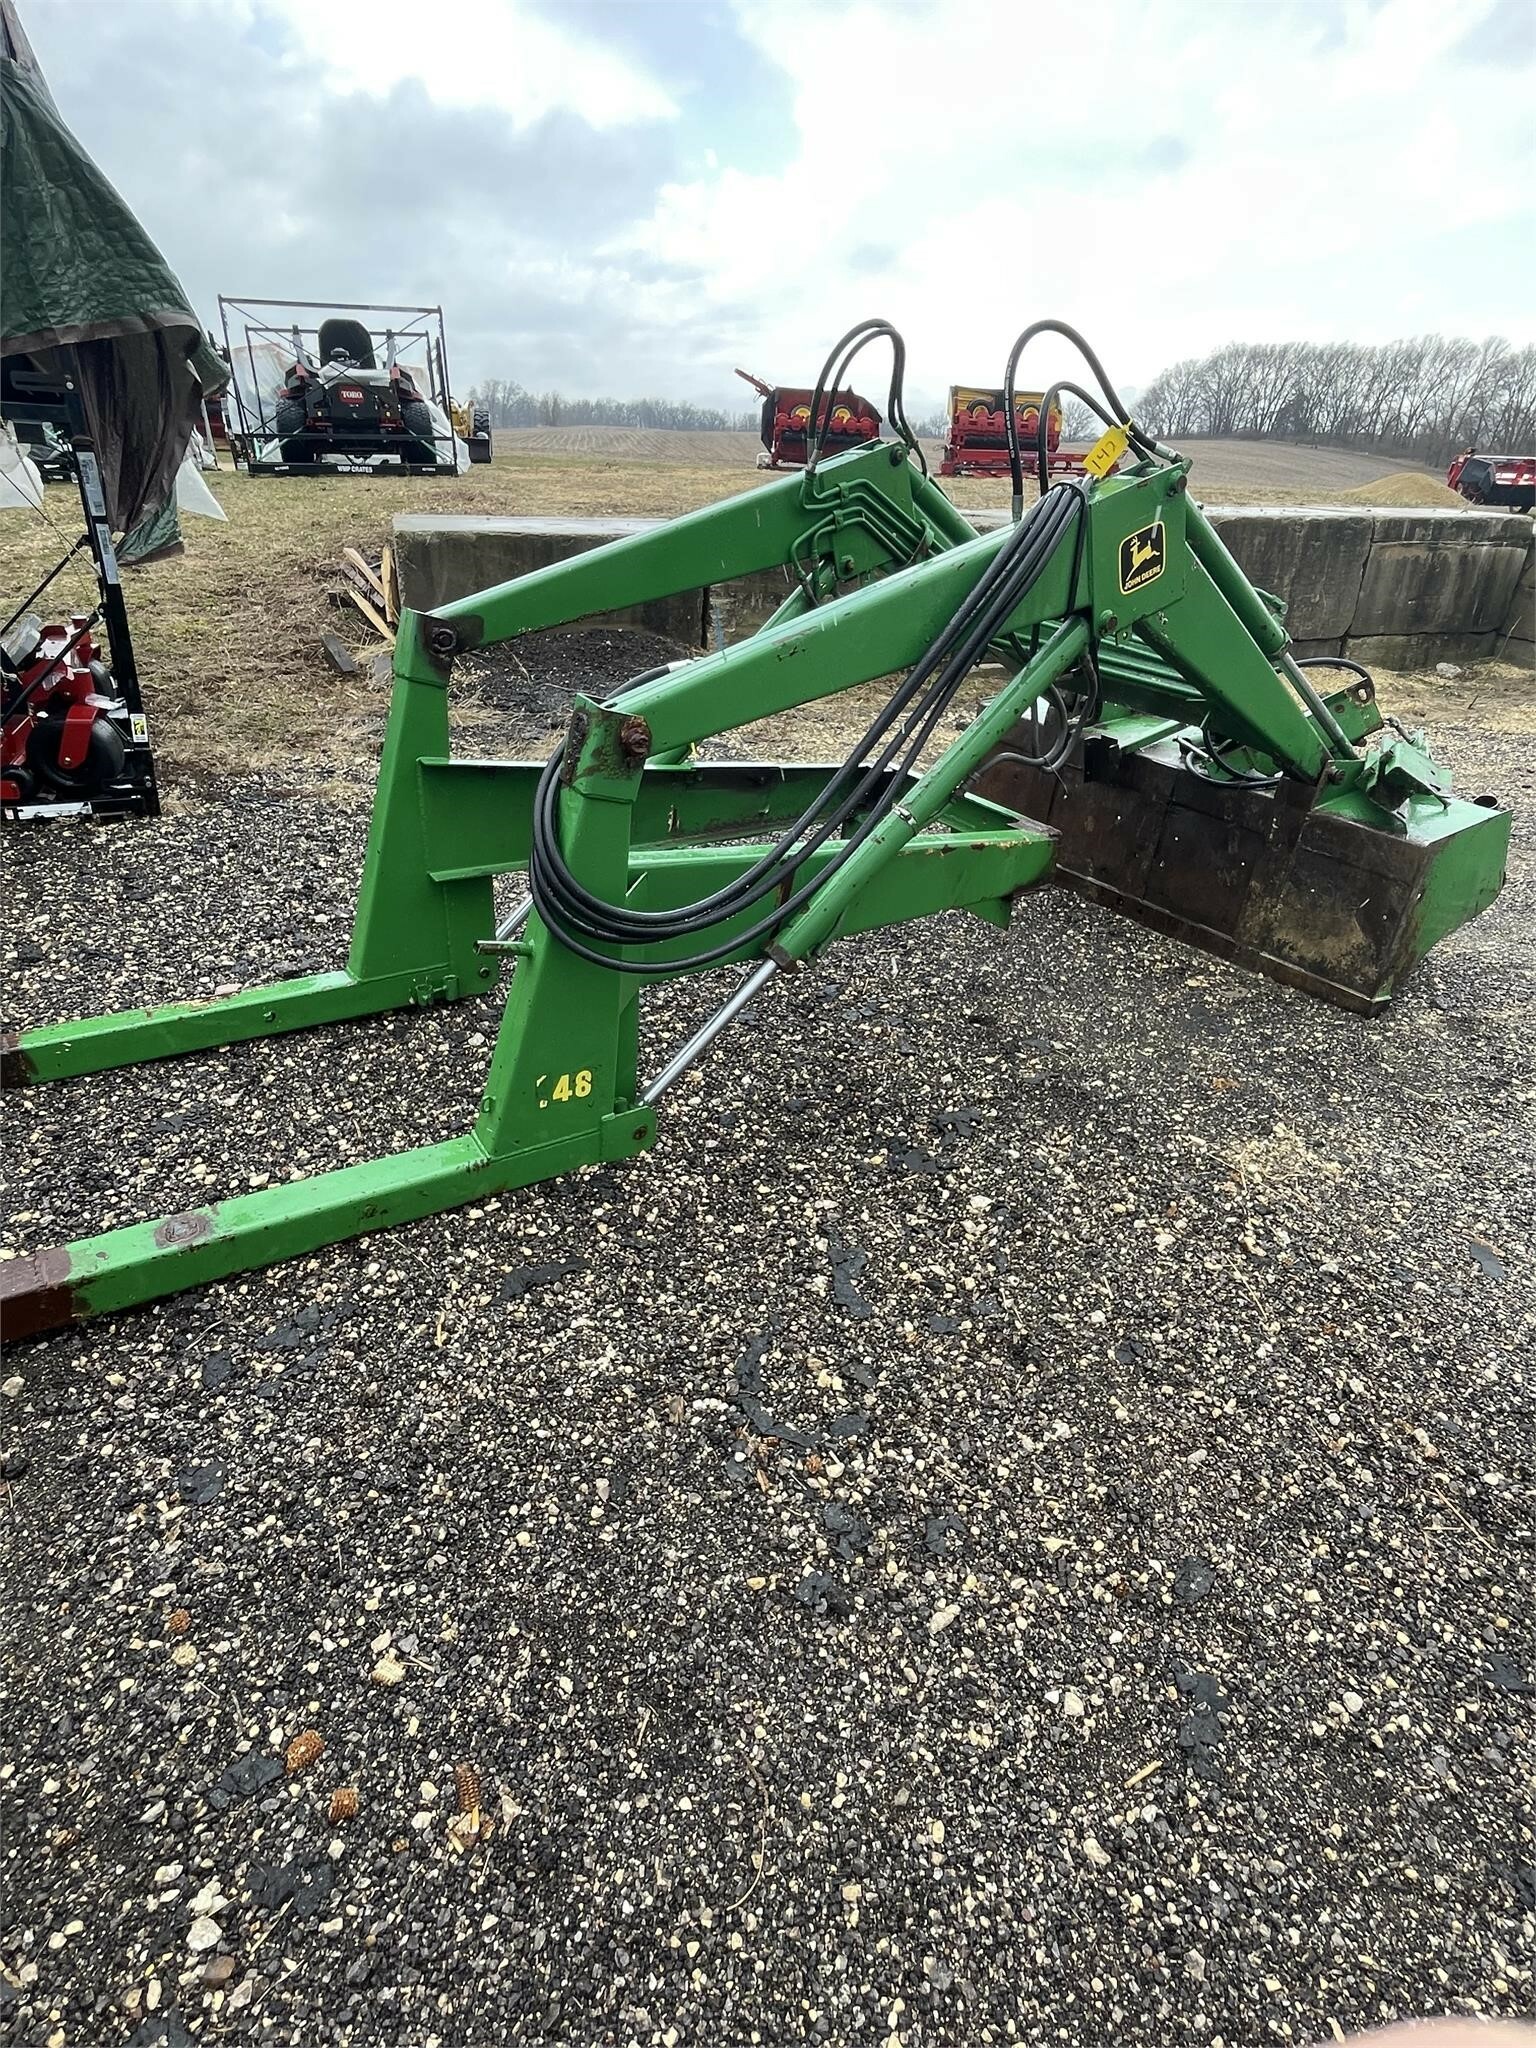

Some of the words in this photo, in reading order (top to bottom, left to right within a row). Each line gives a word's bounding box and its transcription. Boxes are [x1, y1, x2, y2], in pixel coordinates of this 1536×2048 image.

[341, 390, 363, 399] TORO
[1124, 575, 1141, 590] JOHN
[1141, 564, 1161, 581] DEERE
[536, 1070, 592, 1108] 48
